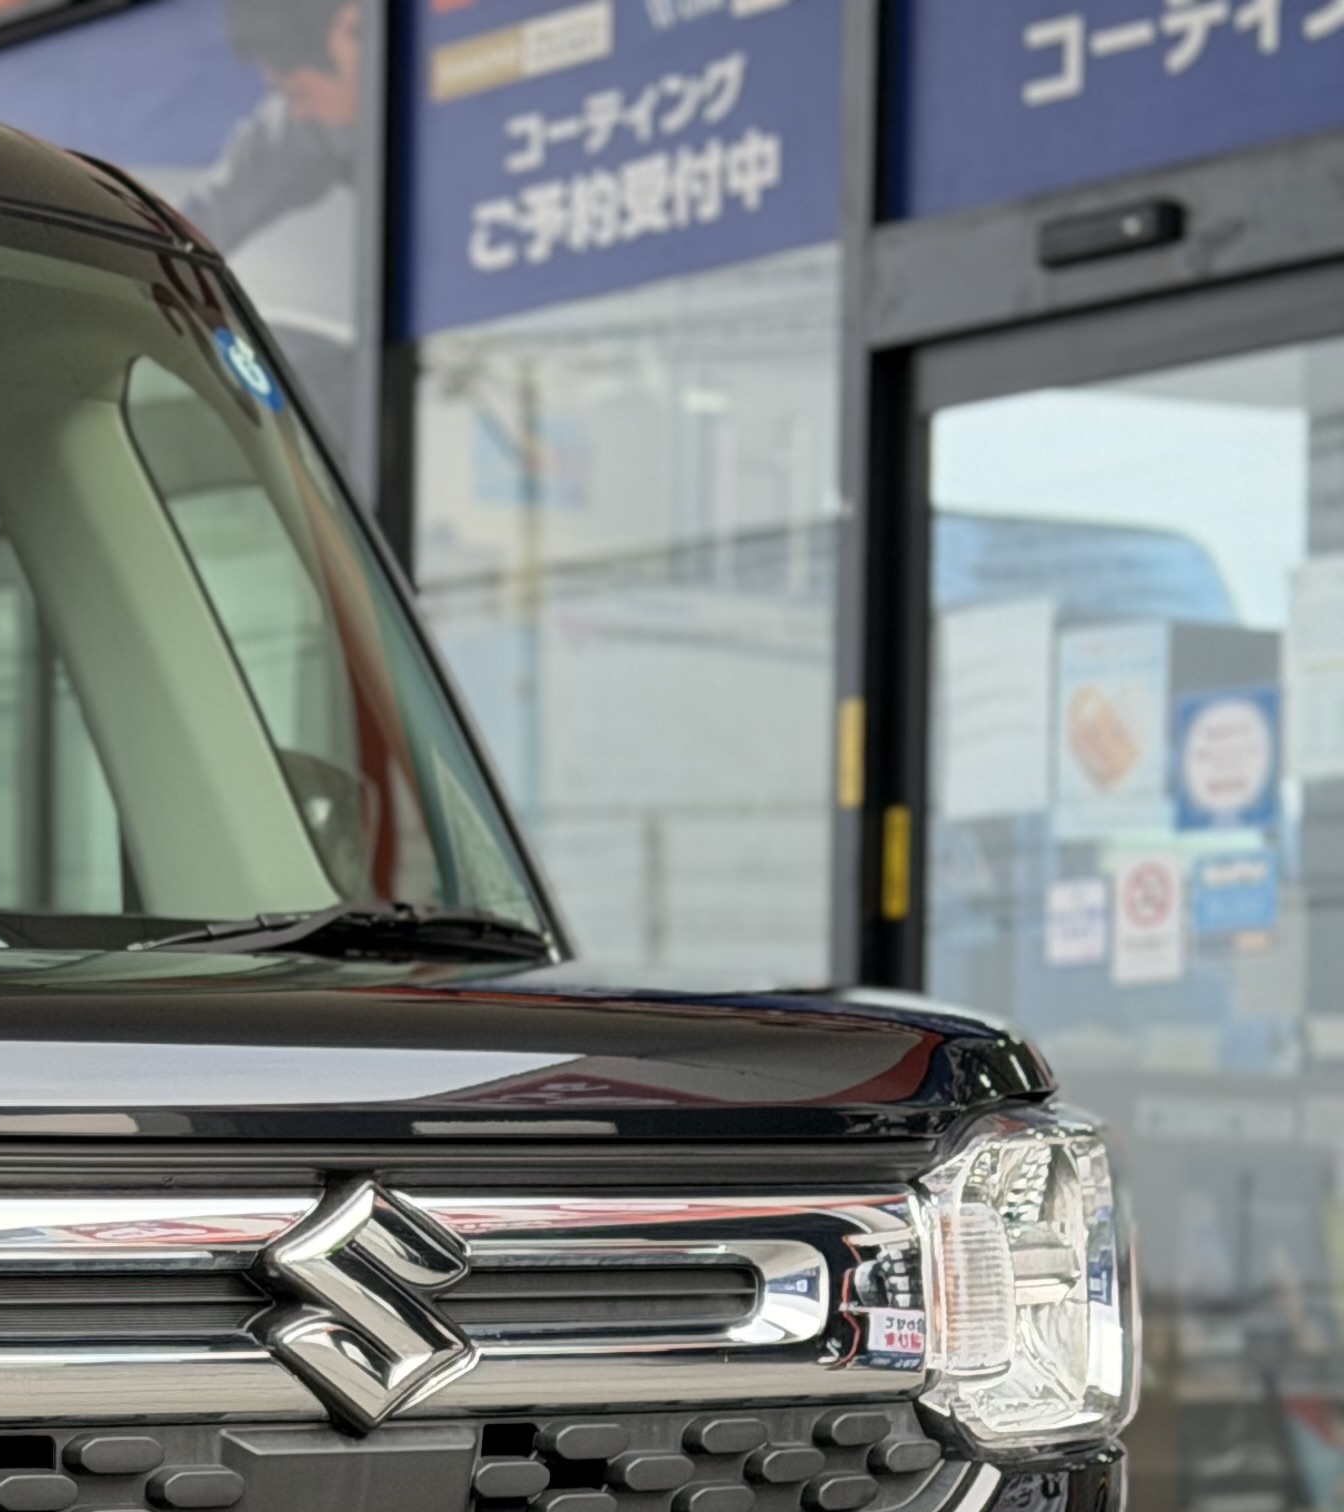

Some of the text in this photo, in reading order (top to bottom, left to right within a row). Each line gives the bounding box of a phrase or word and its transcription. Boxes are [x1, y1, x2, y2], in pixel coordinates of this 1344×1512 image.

[505, 52, 745, 174] コーティング
[1023, 0, 1344, 106] コーティ
[469, 130, 782, 272] ご予約受付中
